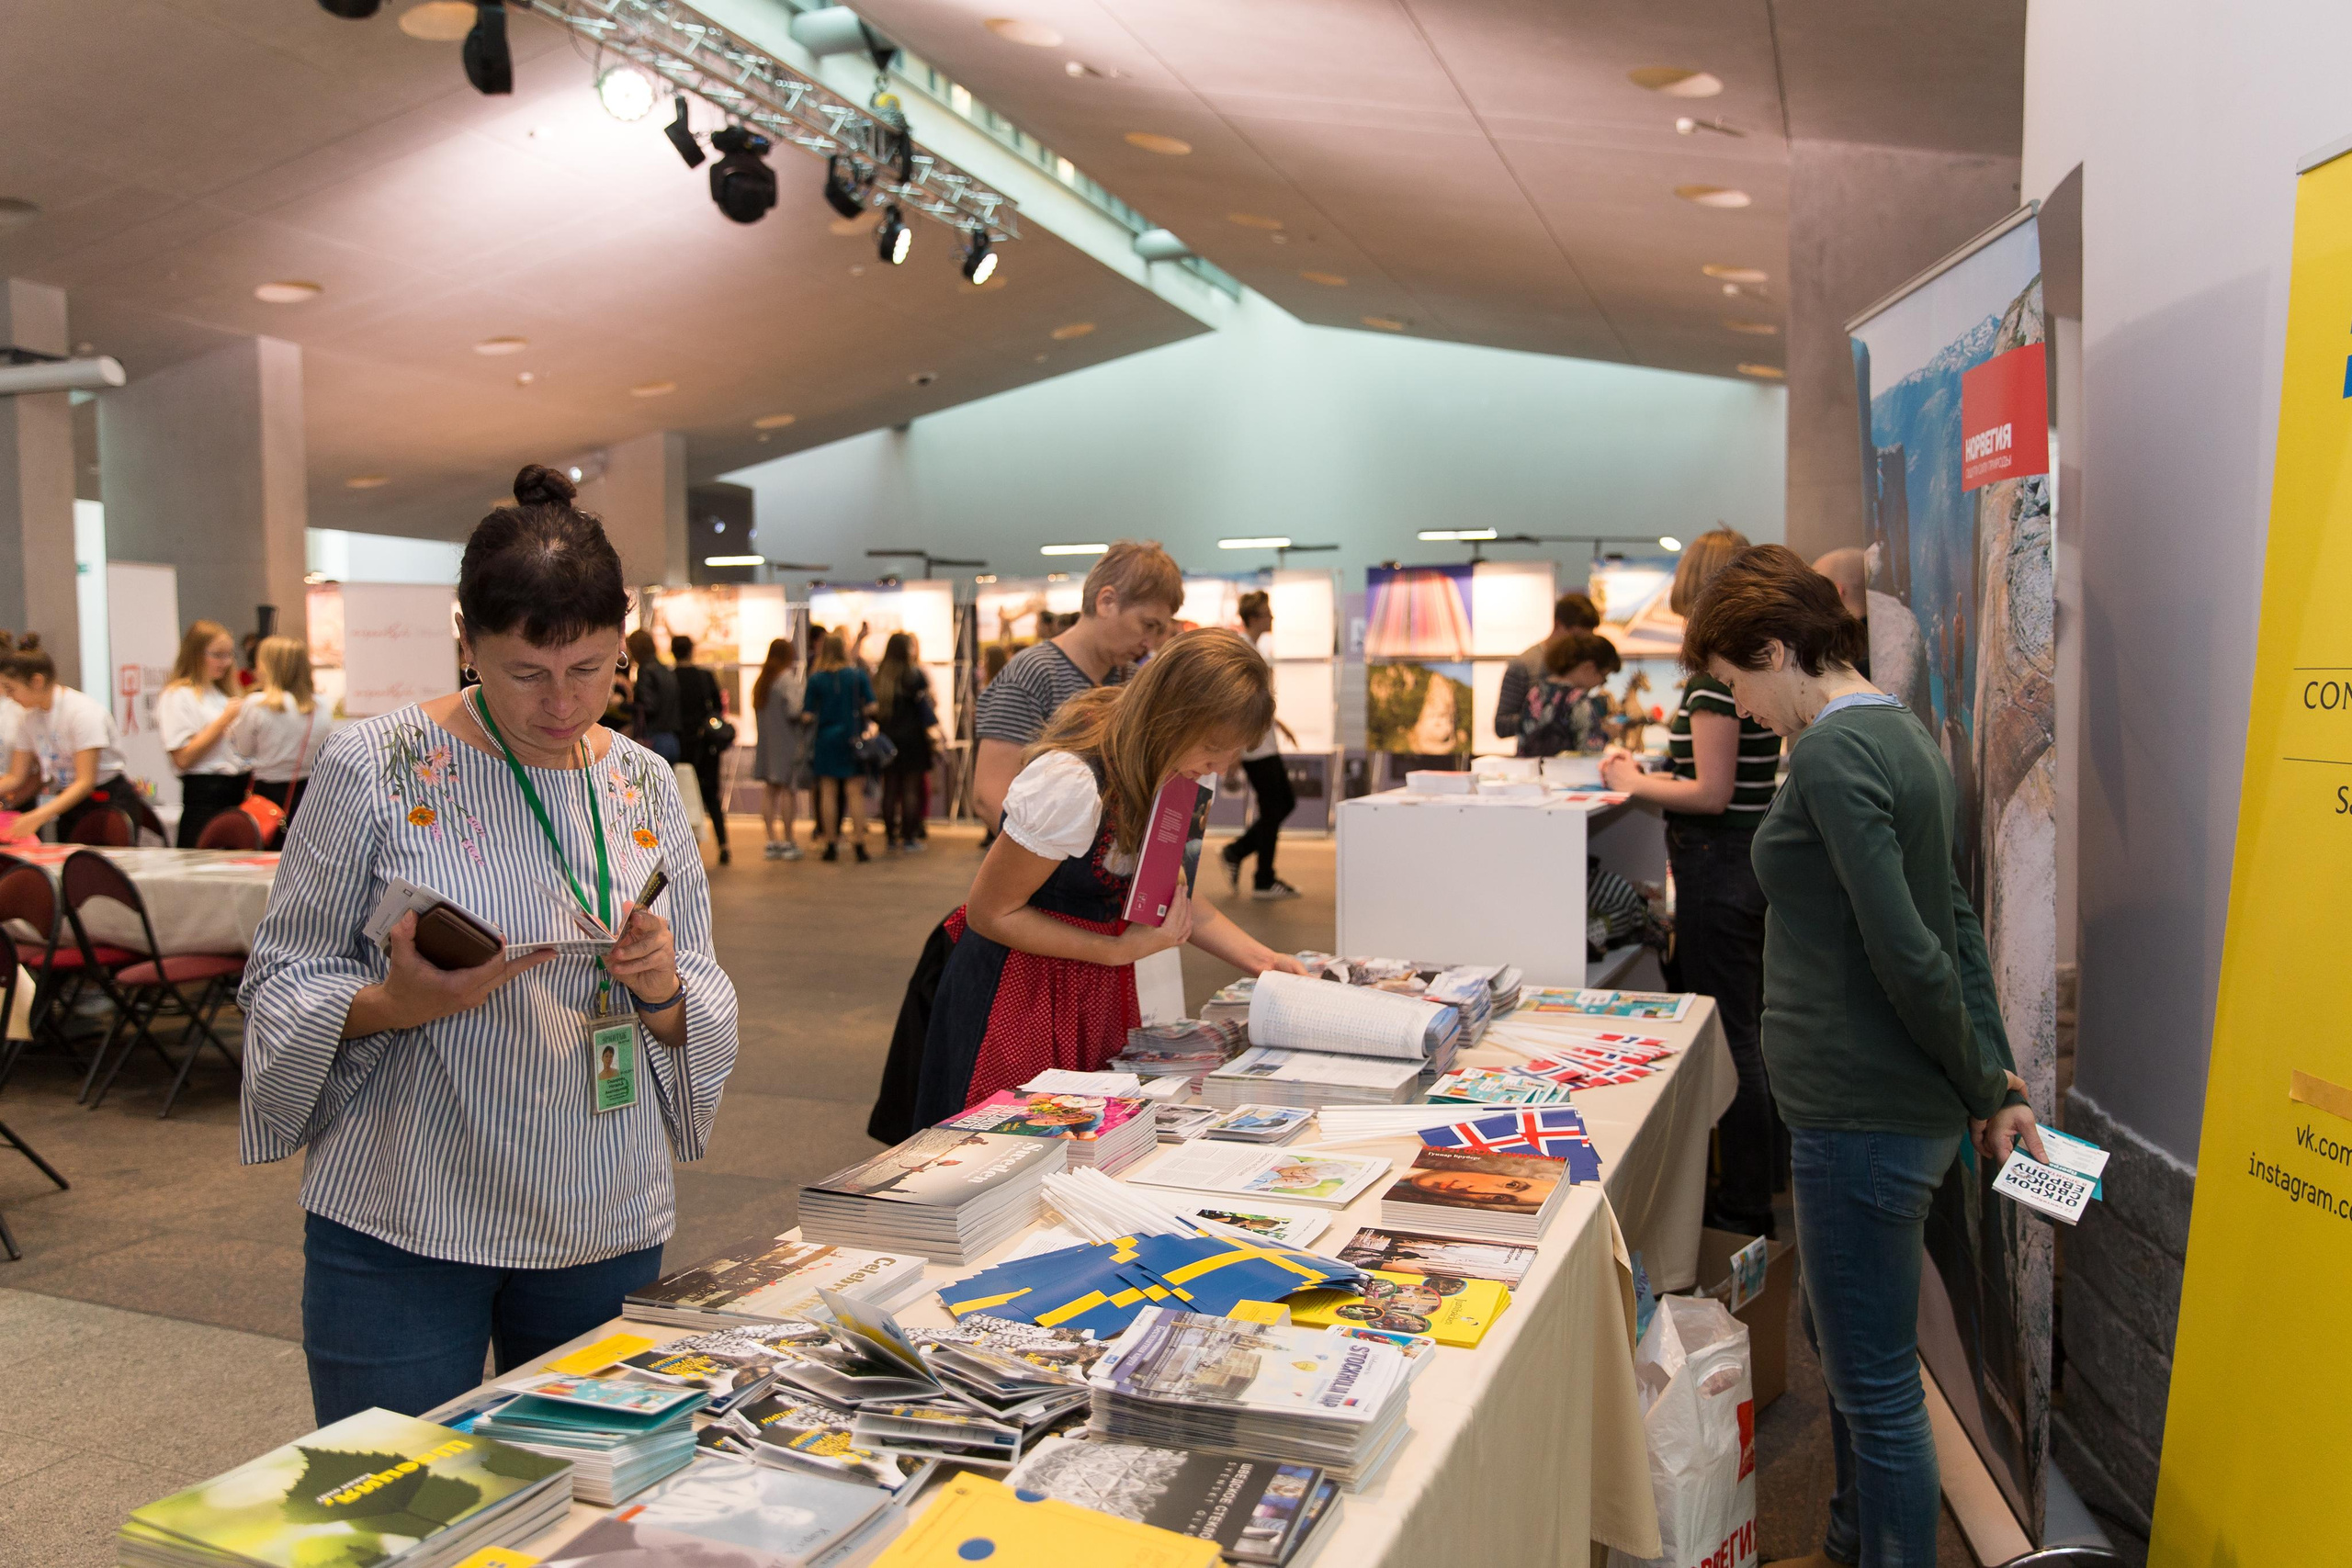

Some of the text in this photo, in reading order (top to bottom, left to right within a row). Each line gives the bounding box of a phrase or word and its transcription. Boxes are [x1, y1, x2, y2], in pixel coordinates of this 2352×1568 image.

[1965, 423, 2012, 463] НОРВЕГИЯ
[967, 1142, 1044, 1183] Sweden
[2297, 1124, 2352, 1167] vk.com
[2005, 1173, 2078, 1208] ОТКРОЙ
[2013, 1162, 2086, 1193] ЕВРОПУ
[2248, 1151, 2352, 1222] instagram.c
[1326, 1345, 1371, 1394] STOCKHOLM
[1317, 1392, 1345, 1408] MAP
[1198, 1462, 1254, 1540] ШВЕДСКОЕ СТЕКЛО
[1204, 1461, 1237, 1503] SVENSKT
